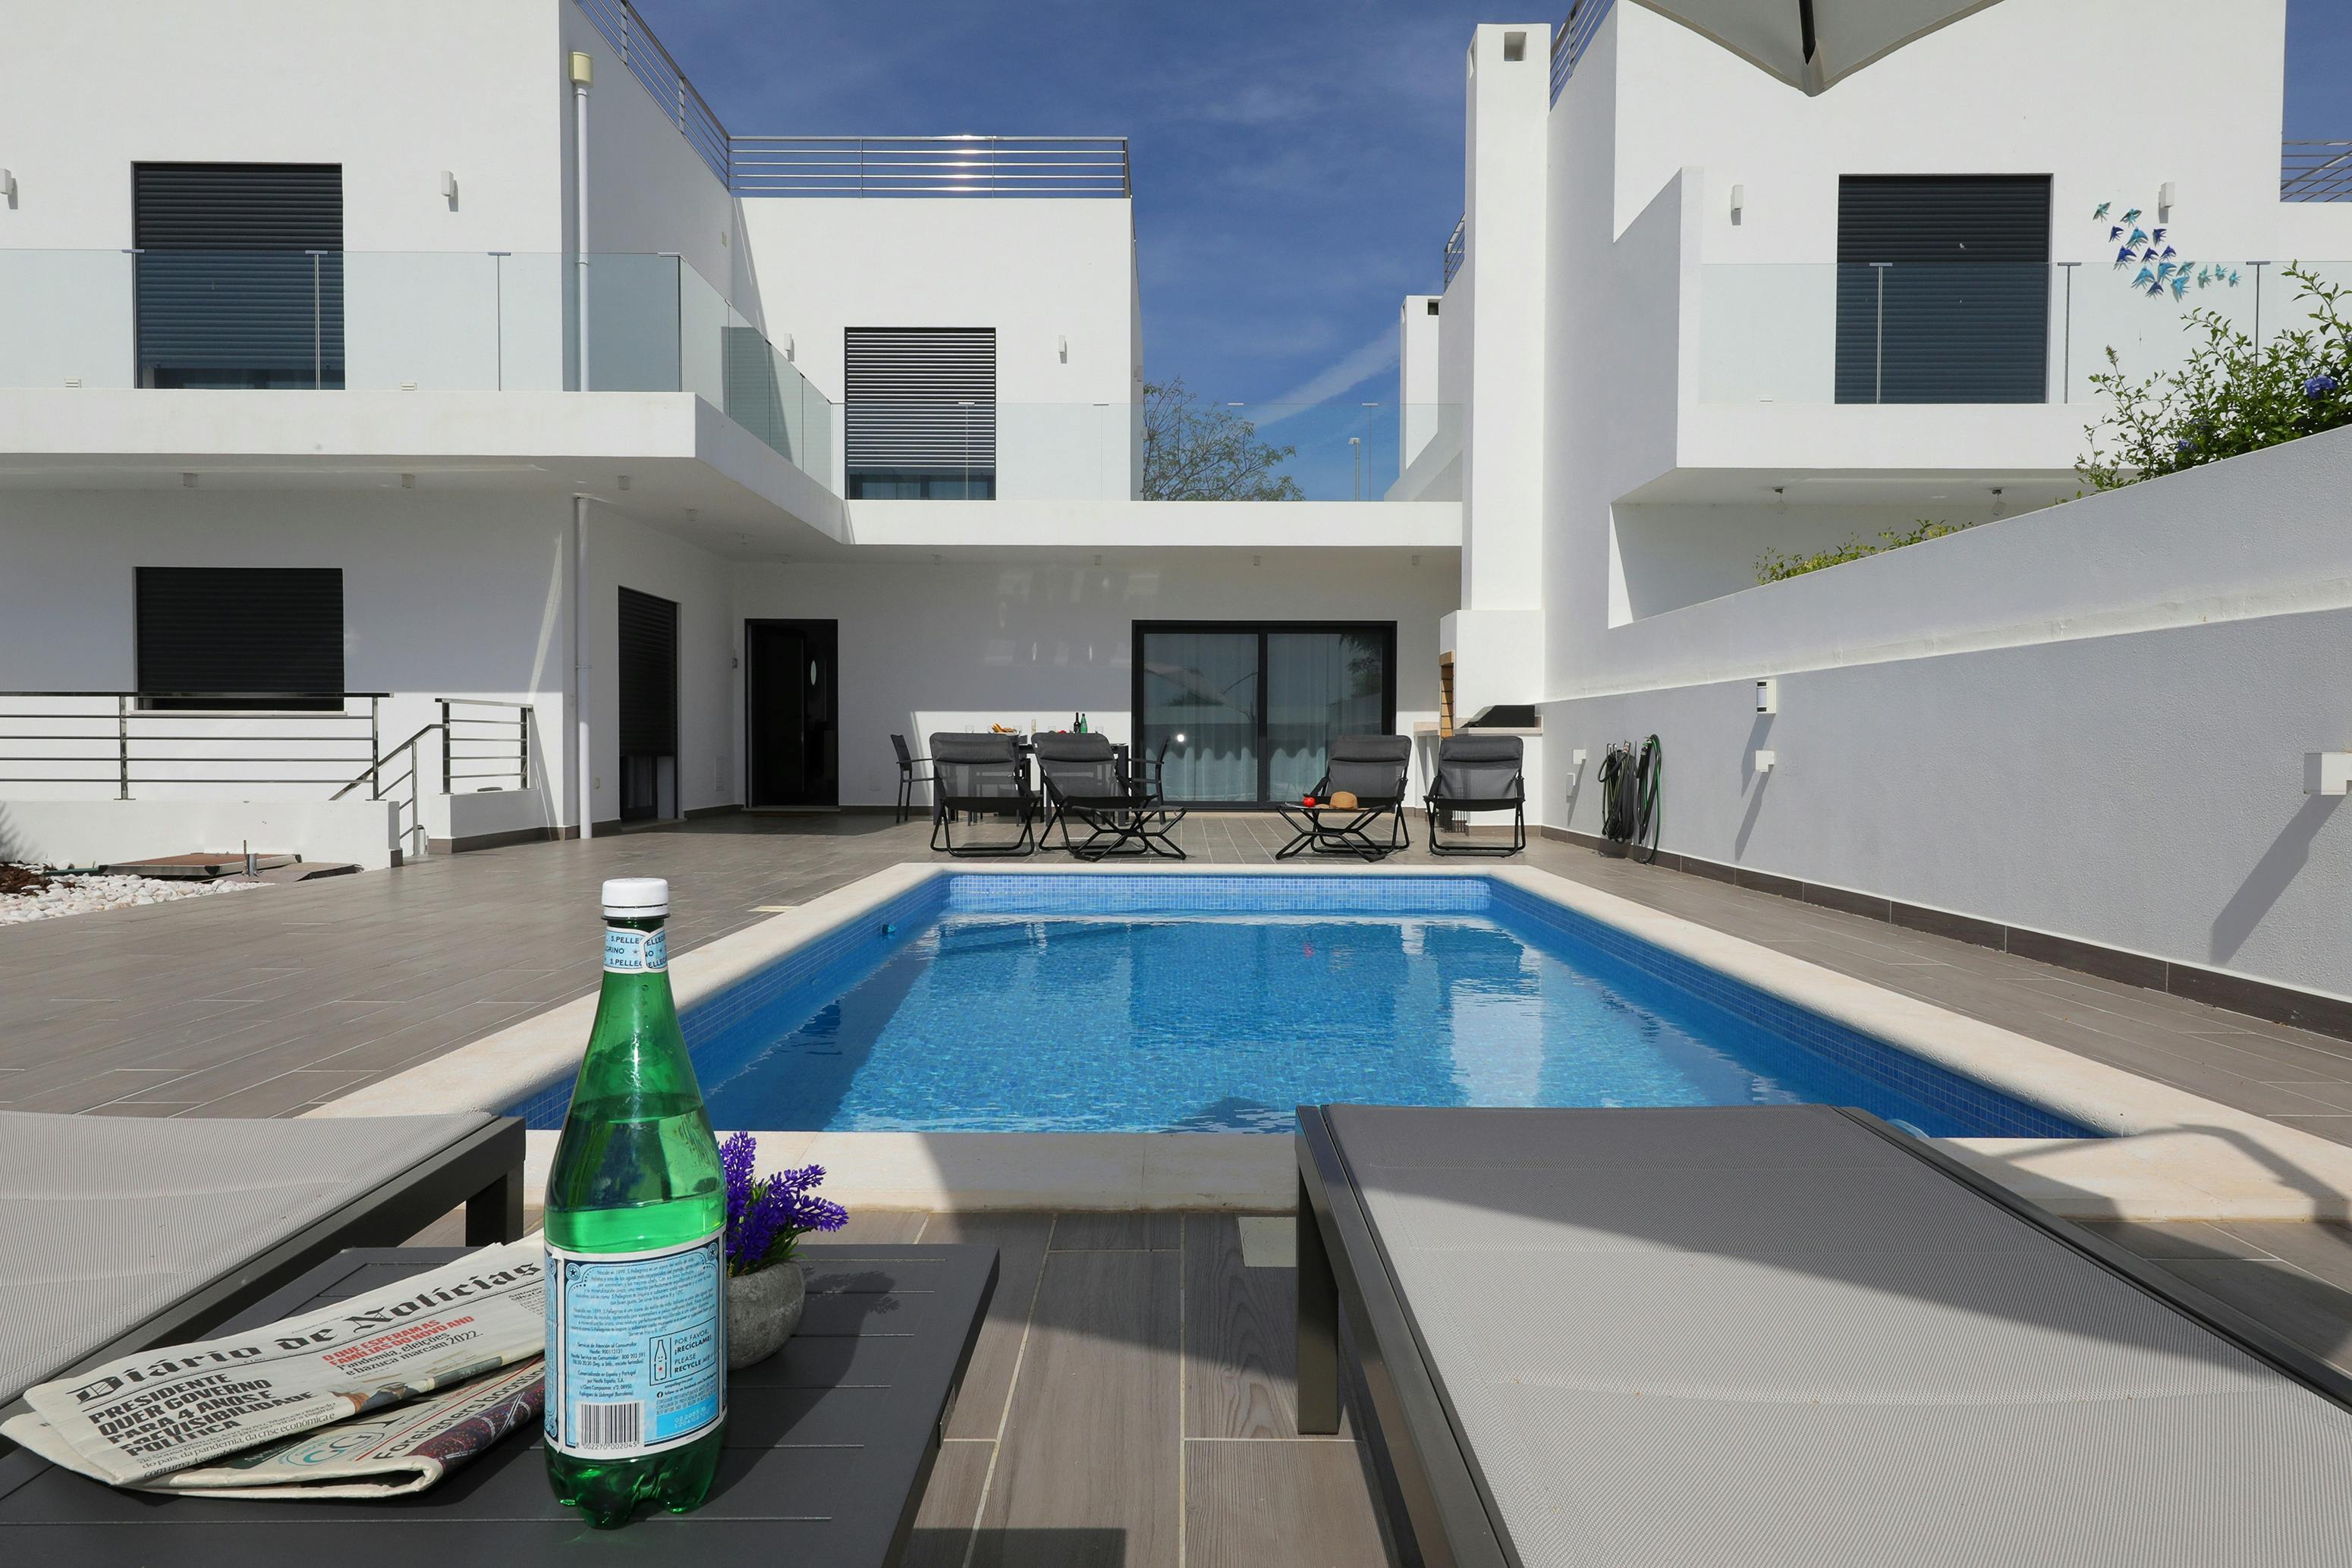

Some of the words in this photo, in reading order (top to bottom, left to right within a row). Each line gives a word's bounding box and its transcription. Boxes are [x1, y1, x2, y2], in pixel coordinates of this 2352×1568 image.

[274, 1328, 338, 1350] de
[334, 1346, 361, 1357] QUE
[360, 1326, 423, 1349] ESPERAM
[421, 1320, 440, 1329] AS
[391, 1337, 412, 1346] DO
[410, 1325, 448, 1340] NOVO
[446, 1316, 475, 1328] ANO
[401, 1332, 450, 1353] eleições
[674, 1337, 687, 1346] POR
[356, 1358, 399, 1374] bazuca
[401, 1342, 448, 1360] marcam
[674, 1353, 696, 1365] PLEASE
[674, 1359, 701, 1373] RECYCLE
[89, 1374, 232, 1424] PRESIDENTE
[98, 1404, 165, 1436] QUER
[164, 1379, 272, 1410] GOVERNO
[107, 1417, 177, 1444] PARA
[178, 1409, 195, 1419] 4
[196, 1394, 256, 1414] ANOS
[258, 1390, 276, 1399] E
[373, 1400, 485, 1460] Foreigners
[142, 1460, 156, 1469] do
[195, 1435, 244, 1456] pandemia,
[246, 1432, 257, 1441] da
[259, 1427, 279, 1438] crise
[281, 1414, 326, 1432] económica
[610, 1442, 637, 1450] 002045
